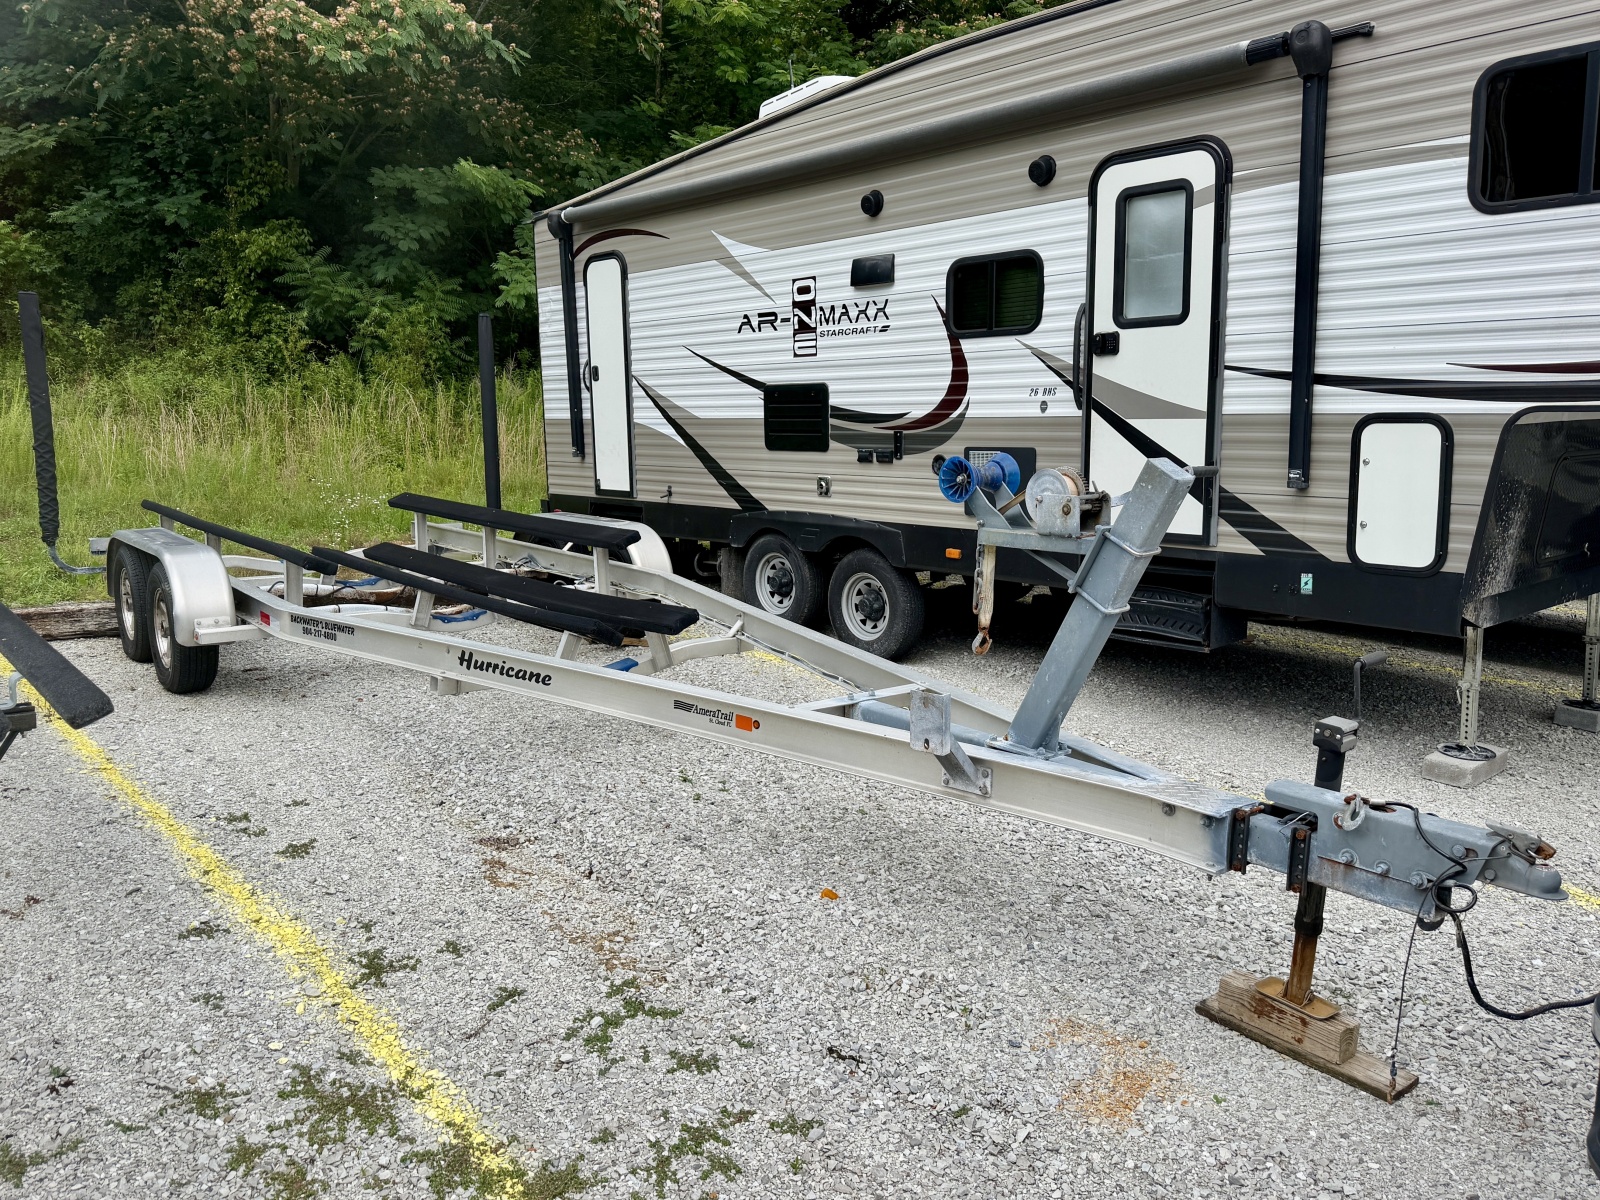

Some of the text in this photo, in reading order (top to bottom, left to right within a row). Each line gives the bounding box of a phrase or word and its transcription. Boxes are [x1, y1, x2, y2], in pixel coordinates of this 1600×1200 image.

[819, 298, 890, 326] MAXX
[819, 325, 880, 338] STARCRAFT
[1029, 387, 1040, 397] 26
[290, 614, 320, 629] BACKWATER
[324, 621, 356, 637] BLUEWATER
[457, 649, 553, 686] Hurricane
[692, 704, 734, 722] AmeraTrail
